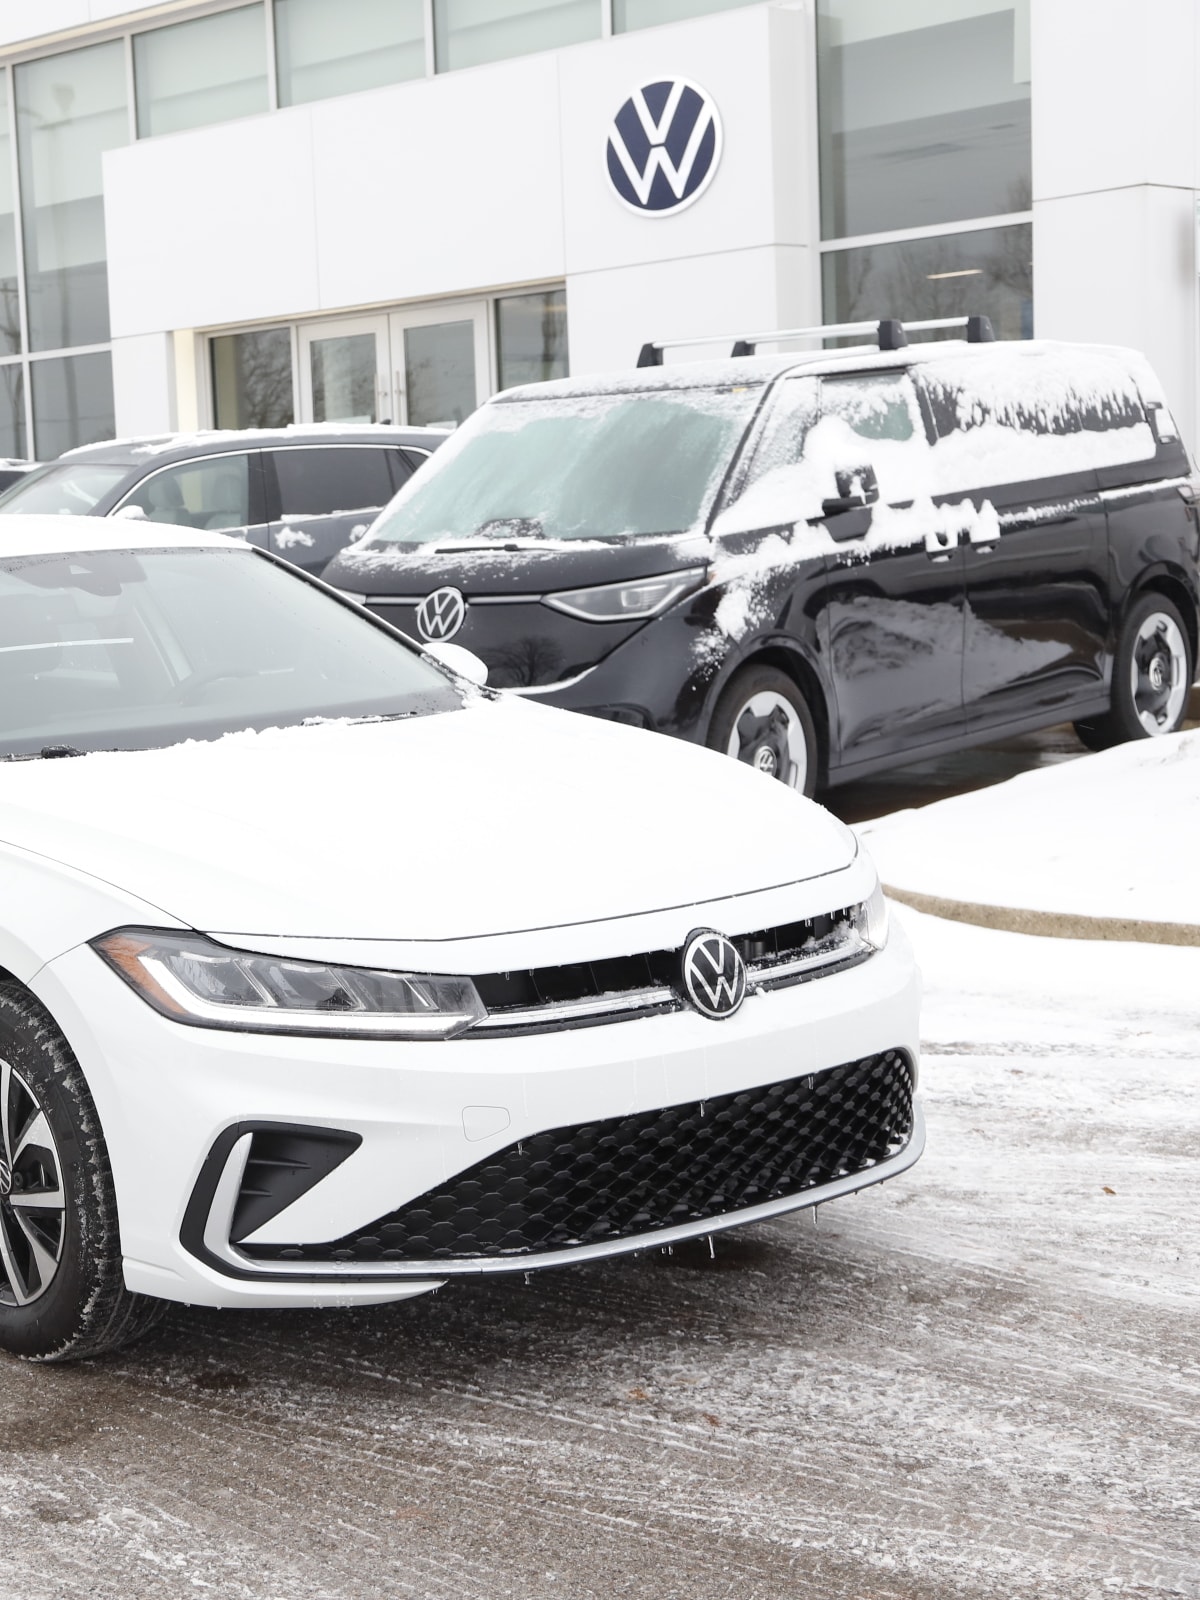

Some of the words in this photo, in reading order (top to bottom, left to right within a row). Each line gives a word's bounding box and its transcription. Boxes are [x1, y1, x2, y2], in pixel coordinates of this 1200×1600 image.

[604, 77, 718, 208] VW
[421, 591, 462, 638] VW
[688, 937, 741, 1011] VW
